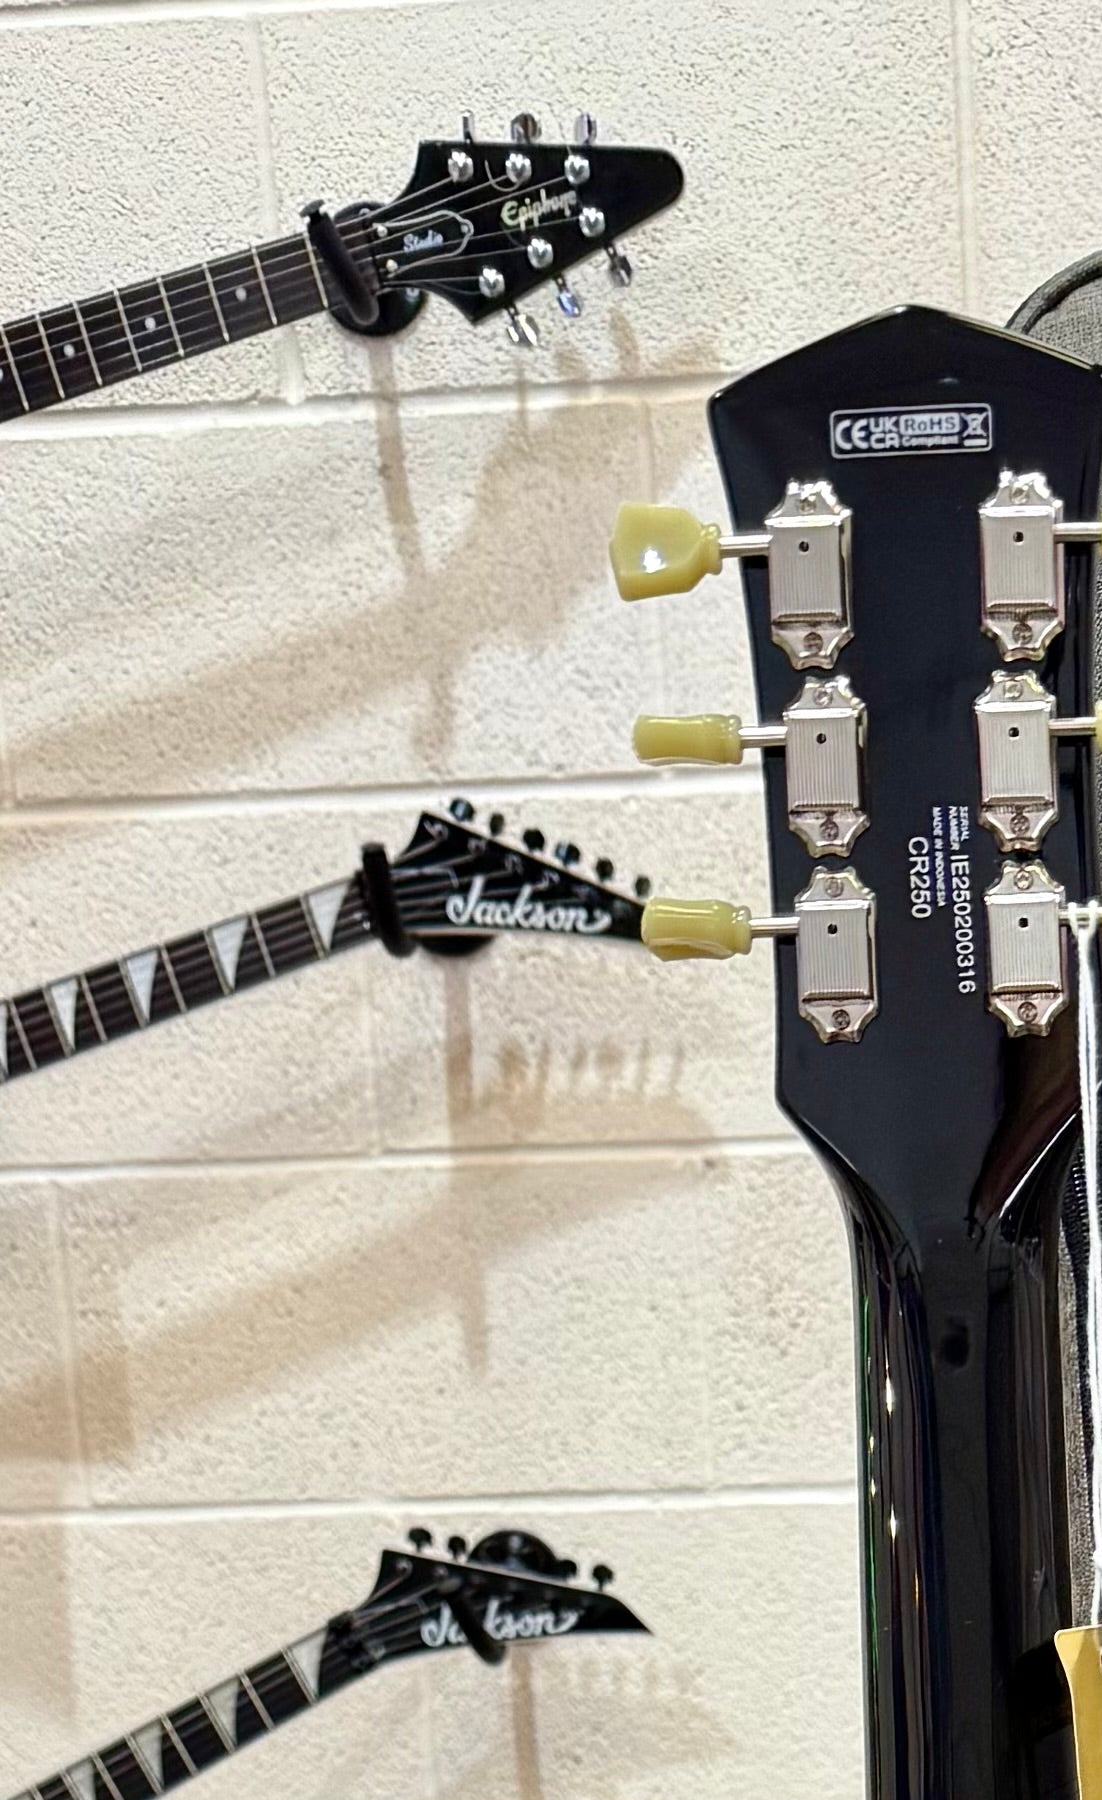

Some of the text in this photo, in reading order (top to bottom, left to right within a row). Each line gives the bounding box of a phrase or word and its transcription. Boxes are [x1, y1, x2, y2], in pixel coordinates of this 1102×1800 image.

[869, 416, 898, 433] UK
[903, 416, 955, 432] RoHS
[870, 433, 899, 449] CA
[933, 806, 943, 836] MADE
[934, 838, 943, 850] IN
[908, 836, 932, 919] CR250
[446, 876, 612, 933] Jackson
[950, 854, 976, 993] IE250200316
[420, 1598, 582, 1648] Jakson
